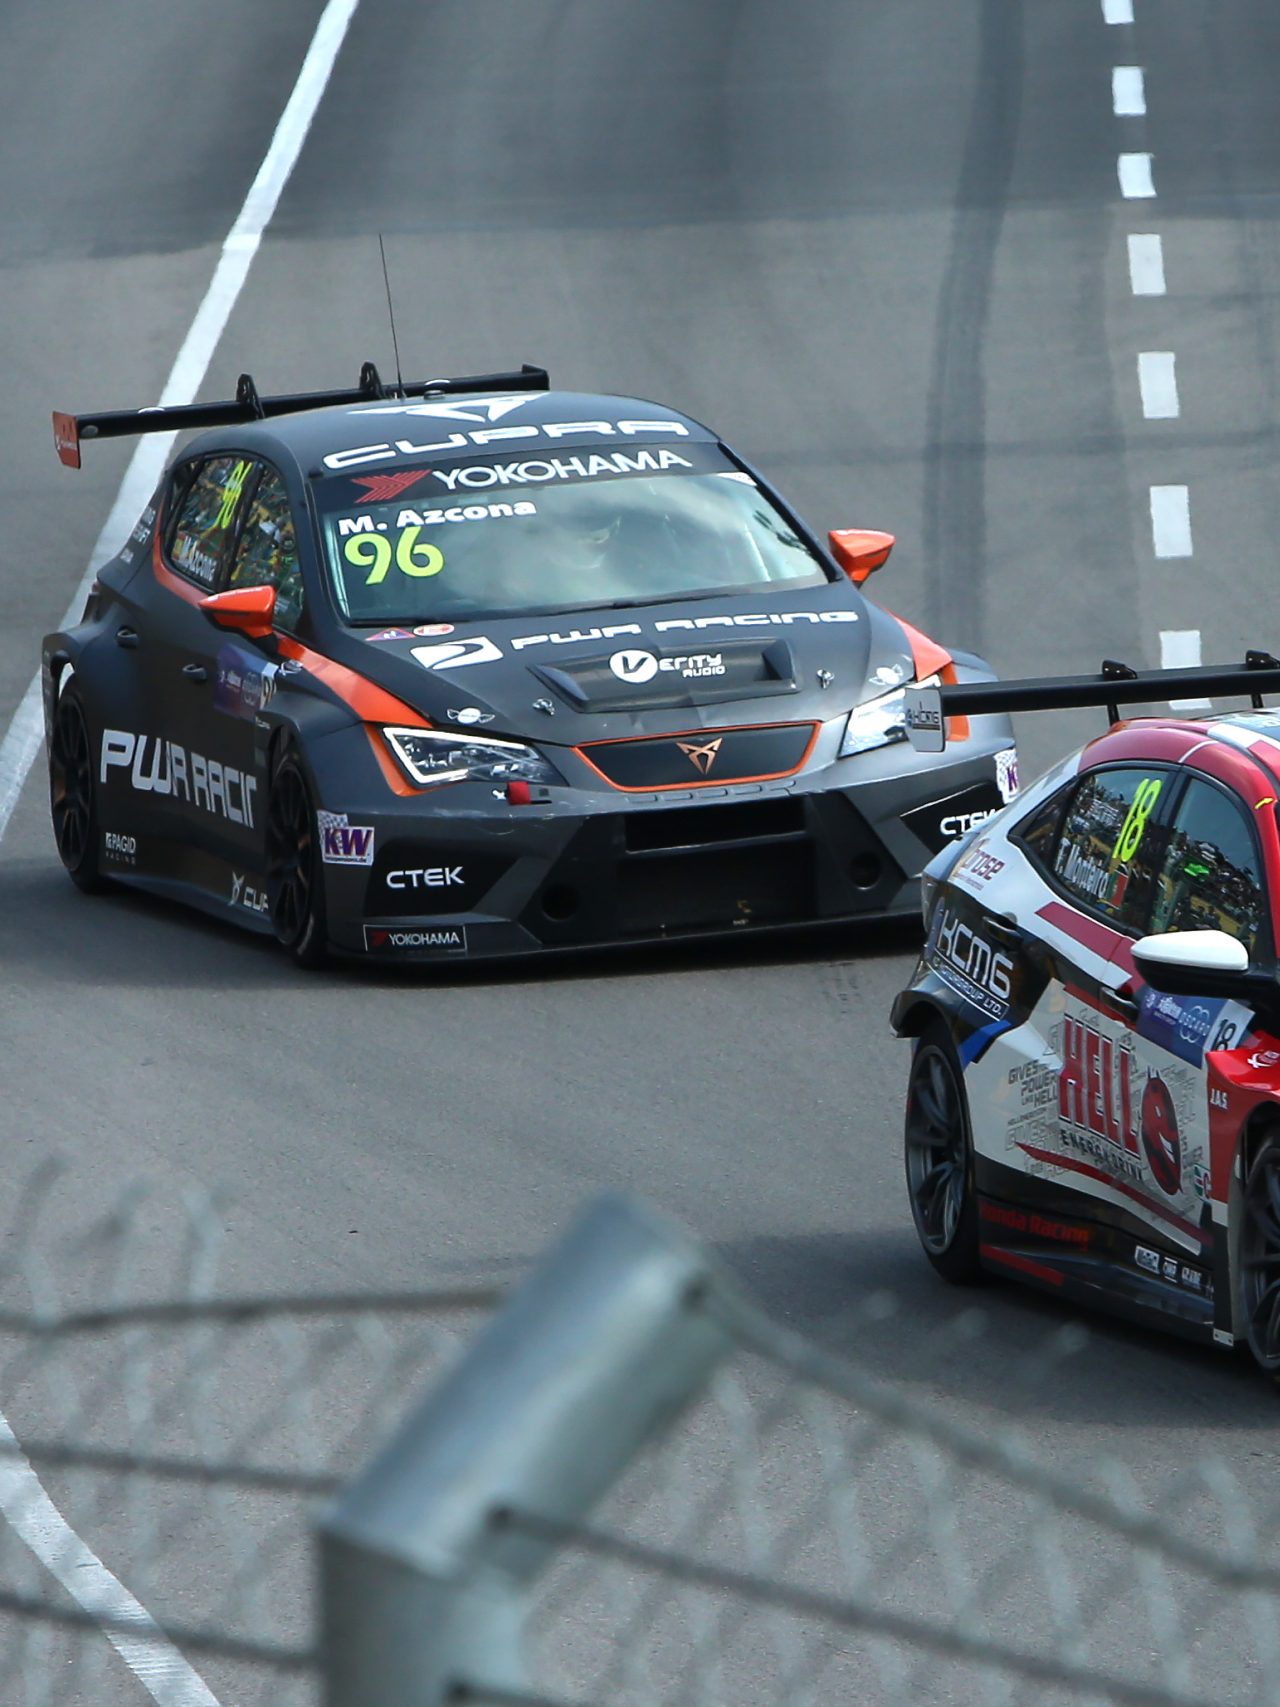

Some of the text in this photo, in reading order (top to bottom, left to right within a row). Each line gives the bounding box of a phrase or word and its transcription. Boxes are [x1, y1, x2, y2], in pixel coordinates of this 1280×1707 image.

[322, 420, 690, 470] CUPRA
[431, 449, 693, 490] YOKOHAMA
[338, 501, 537, 537] M. Azcona
[344, 525, 445, 586] 96
[653, 610, 859, 632] RACING
[682, 665, 726, 679] AUDIO
[1112, 778, 1162, 863] 18
[324, 828, 373, 857] KW
[386, 866, 465, 889] CTEK
[389, 931, 461, 947] YOKOHAMA
[937, 909, 1014, 999] KCMG
[1210, 1018, 1238, 1051] 18
[1058, 1012, 1142, 1160] HELL
